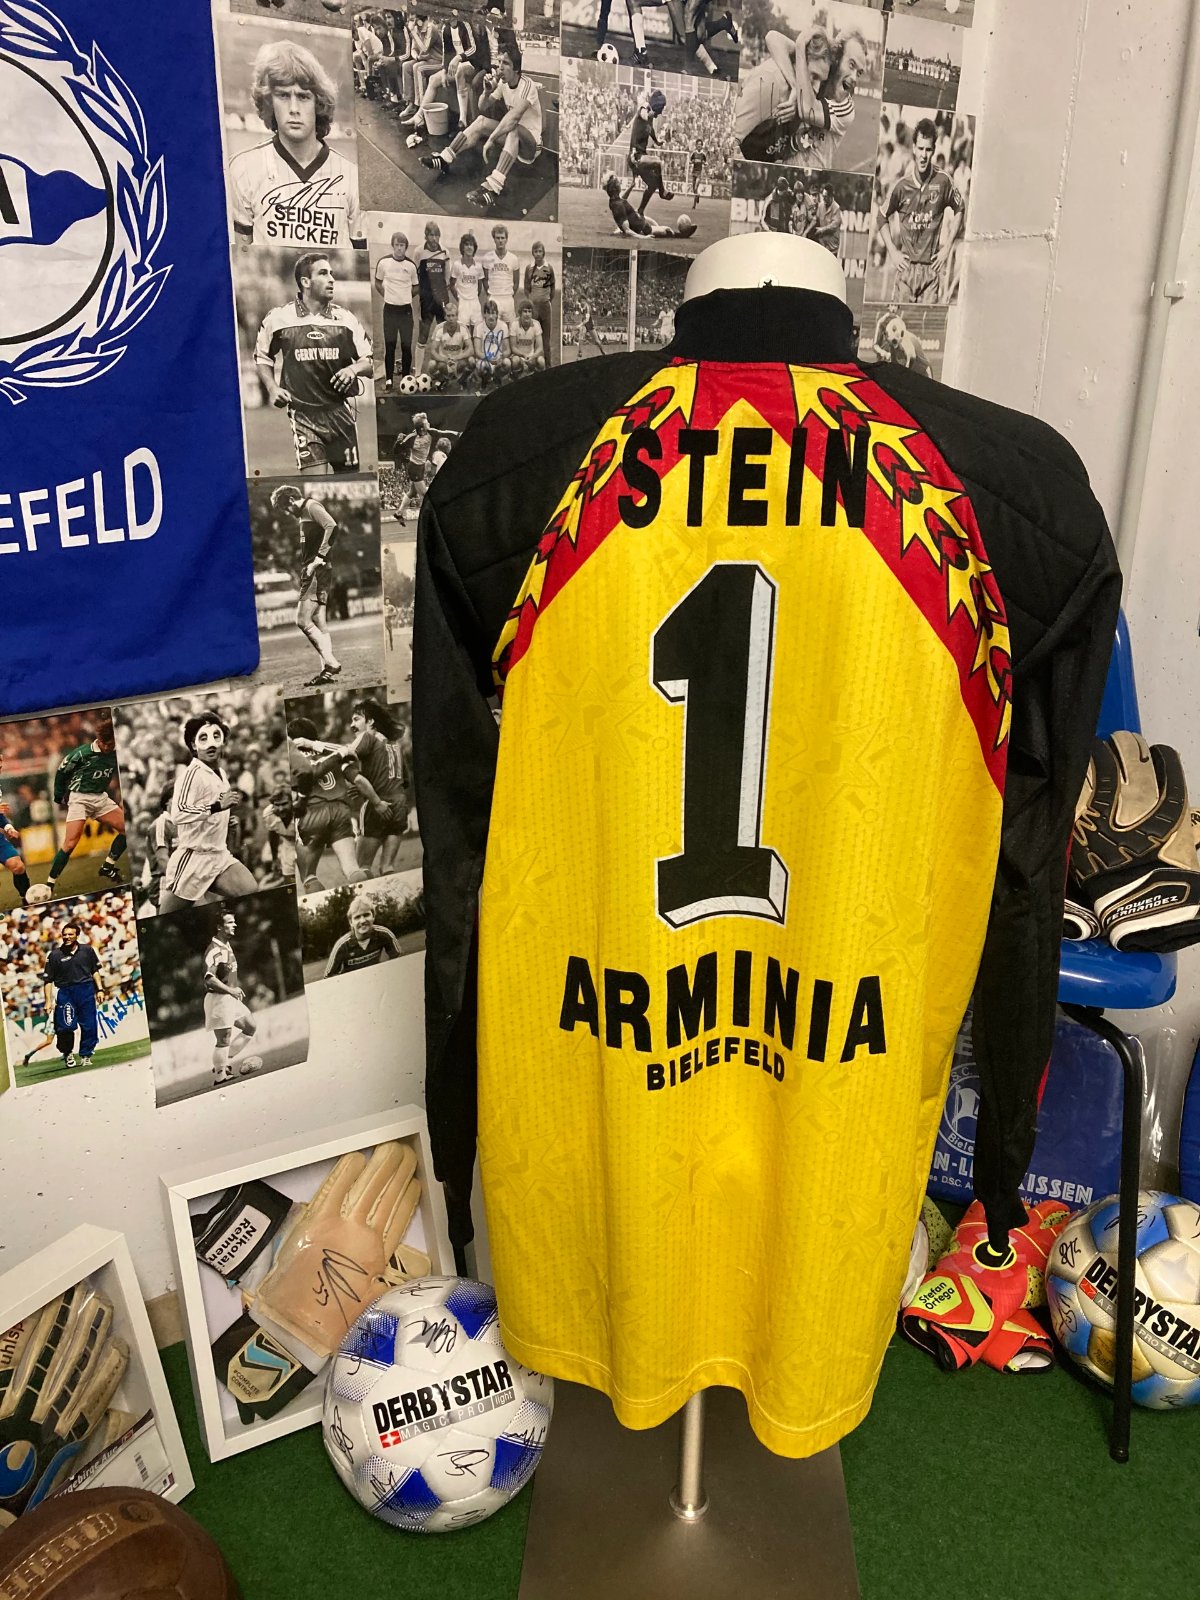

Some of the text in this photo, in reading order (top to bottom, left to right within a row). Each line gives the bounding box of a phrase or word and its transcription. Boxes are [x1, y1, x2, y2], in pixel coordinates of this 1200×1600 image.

[267, 220, 339, 245] STICKER
[275, 203, 335, 228] SEIDEN
[294, 347, 340, 362] GERRY WEBER
[344, 446, 359, 467] 11
[617, 426, 872, 530] STEIN
[650, 560, 789, 930] 1
[559, 950, 887, 1063] ARMINIA
[647, 1036, 786, 1091] BIELEFELD
[208, 1217, 252, 1264] Rehnen
[219, 1225, 257, 1268] Nikolai
[919, 1282, 947, 1304] Stefan
[925, 1287, 955, 1310] Ortega
[231, 1375, 252, 1398] CONTROL
[233, 1369, 260, 1395] #COMPLETE
[372, 1359, 513, 1434] DERBYSTAR
[400, 1390, 514, 1441] MAGIC PRO light
